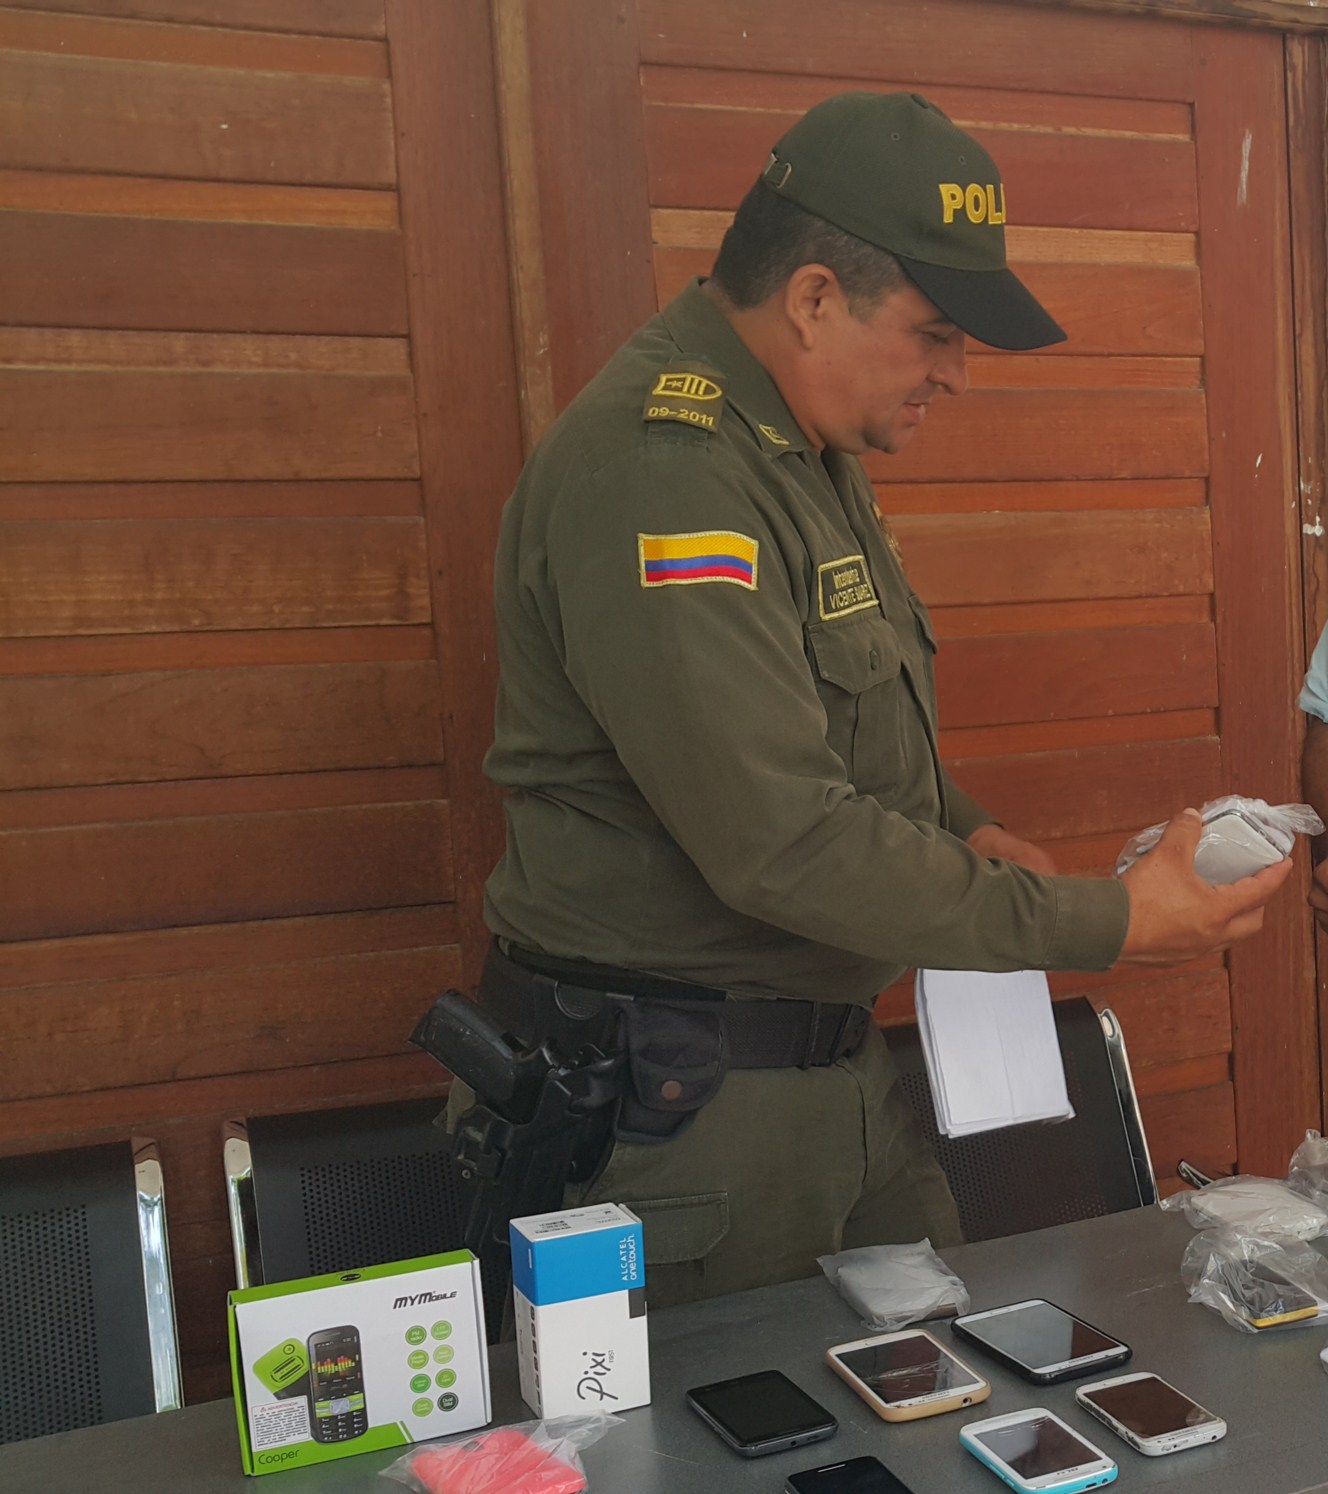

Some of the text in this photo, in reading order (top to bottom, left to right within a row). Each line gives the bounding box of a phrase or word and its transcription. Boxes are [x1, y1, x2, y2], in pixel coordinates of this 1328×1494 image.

[648, 407, 714, 426] 09-2011
[619, 1237, 628, 1281] ALCATEL
[258, 1450, 300, 1464] Cooper
